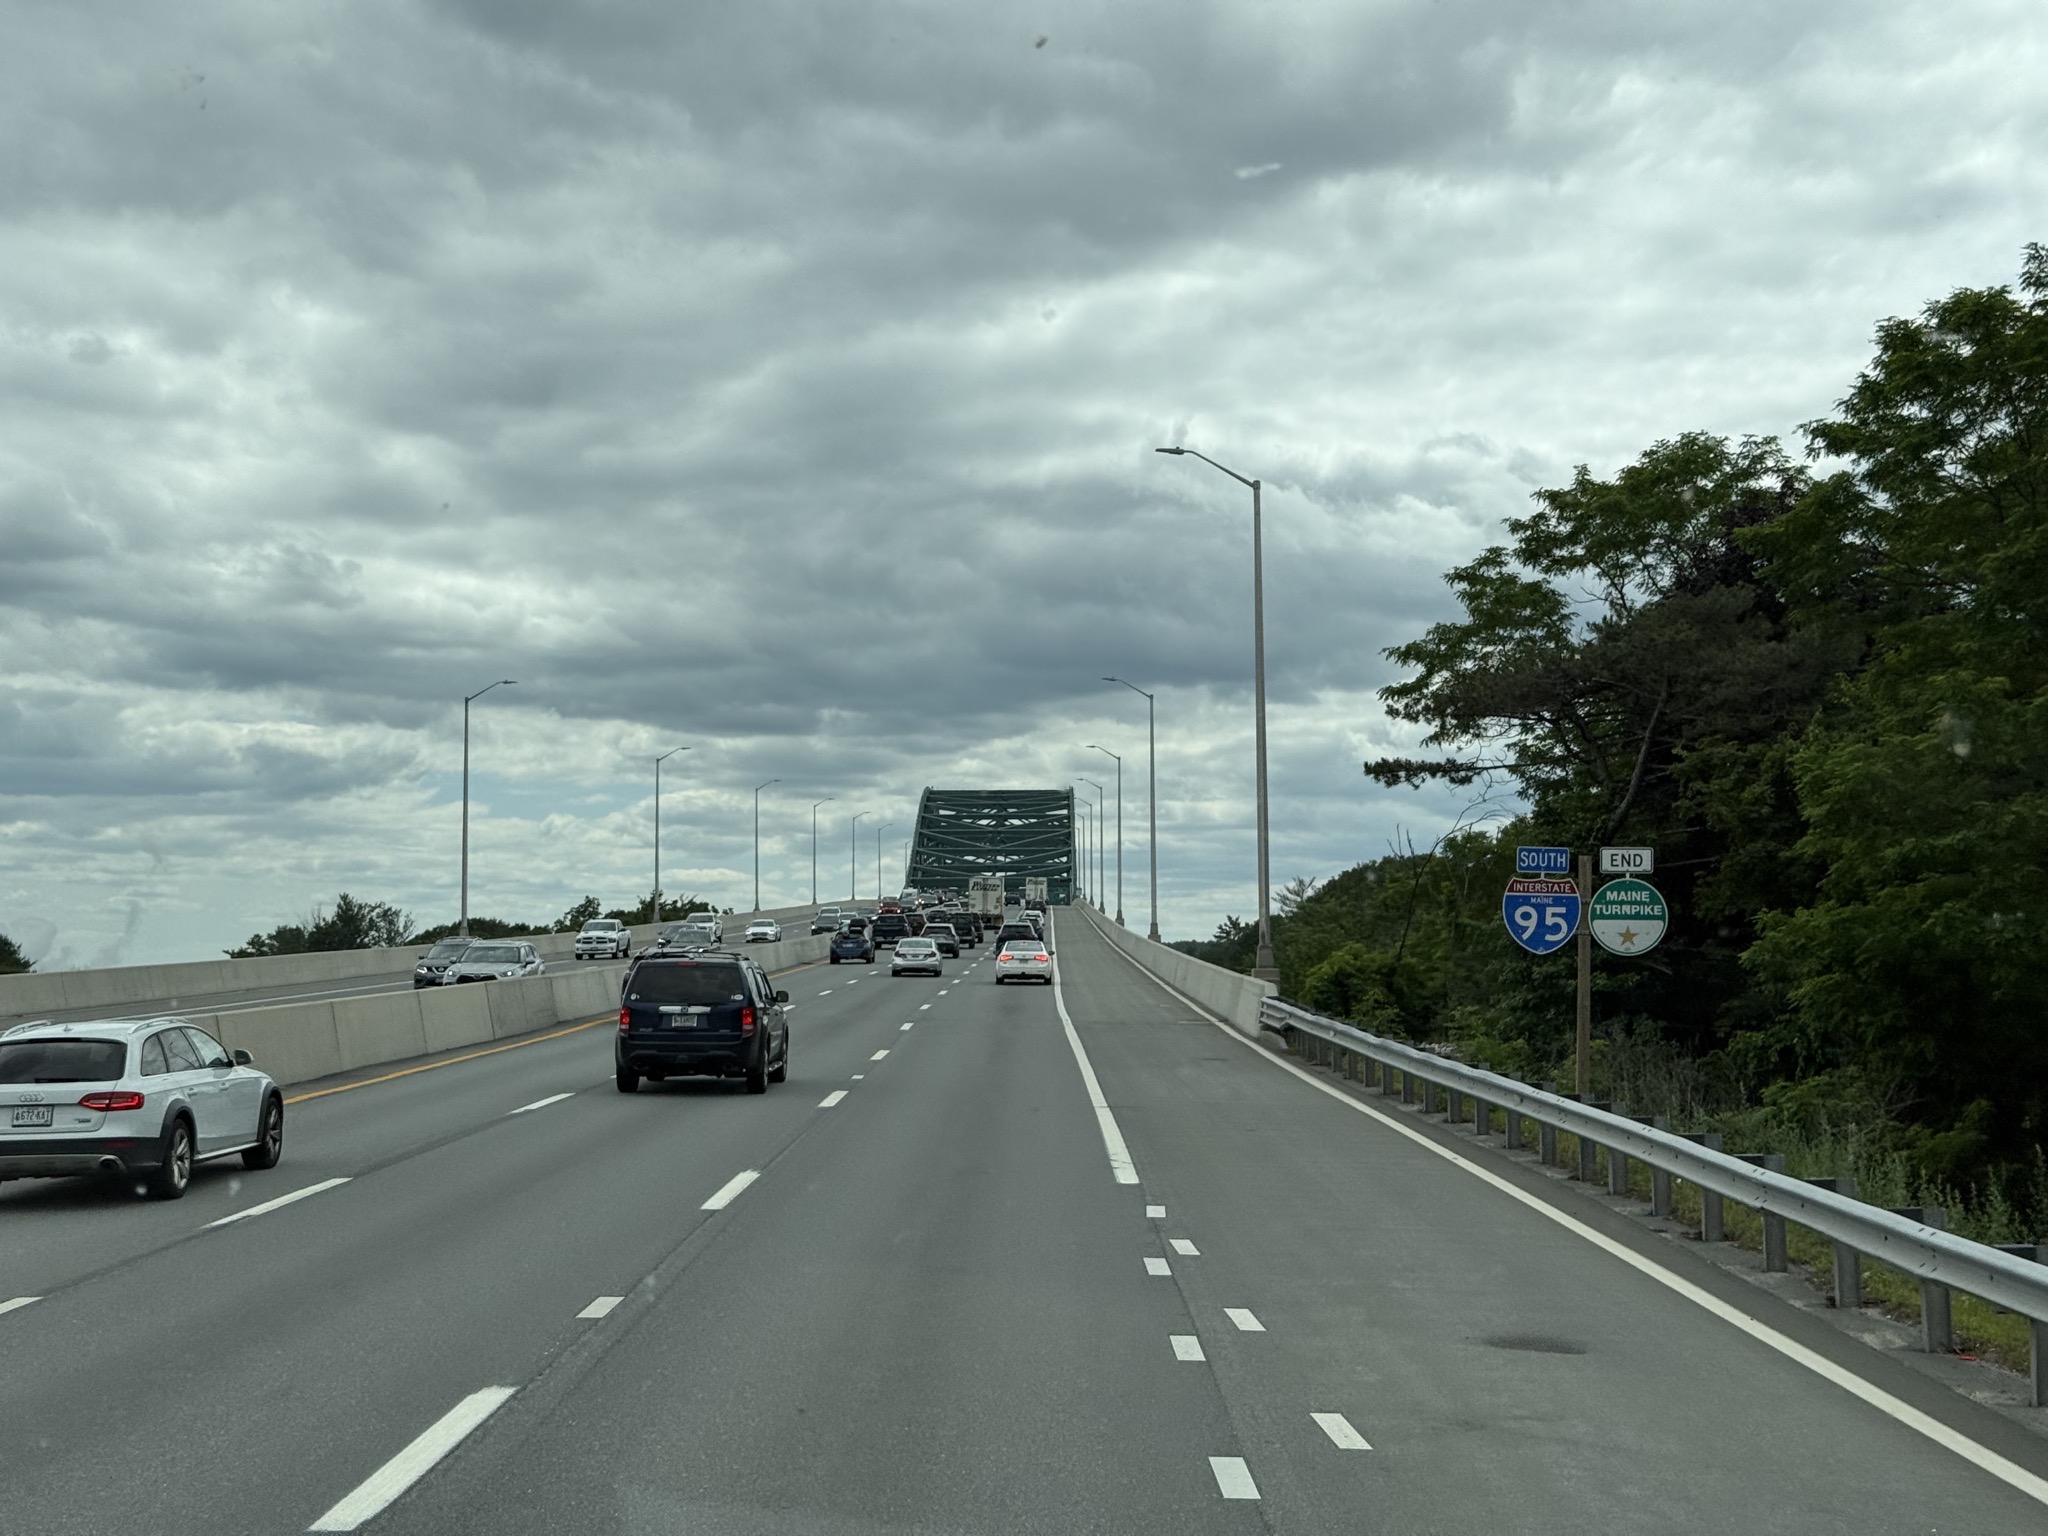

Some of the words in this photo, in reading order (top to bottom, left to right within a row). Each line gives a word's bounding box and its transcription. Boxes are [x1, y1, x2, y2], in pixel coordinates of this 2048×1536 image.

[1520, 851, 1566, 868] SOUTH
[1610, 853, 1644, 867] END
[1513, 882, 1572, 893] INTERSTATE
[1530, 896, 1554, 905] MAINE
[1606, 890, 1650, 902] MAINE
[1593, 904, 1663, 916] TURNPIKE
[1514, 905, 1568, 942] 95
